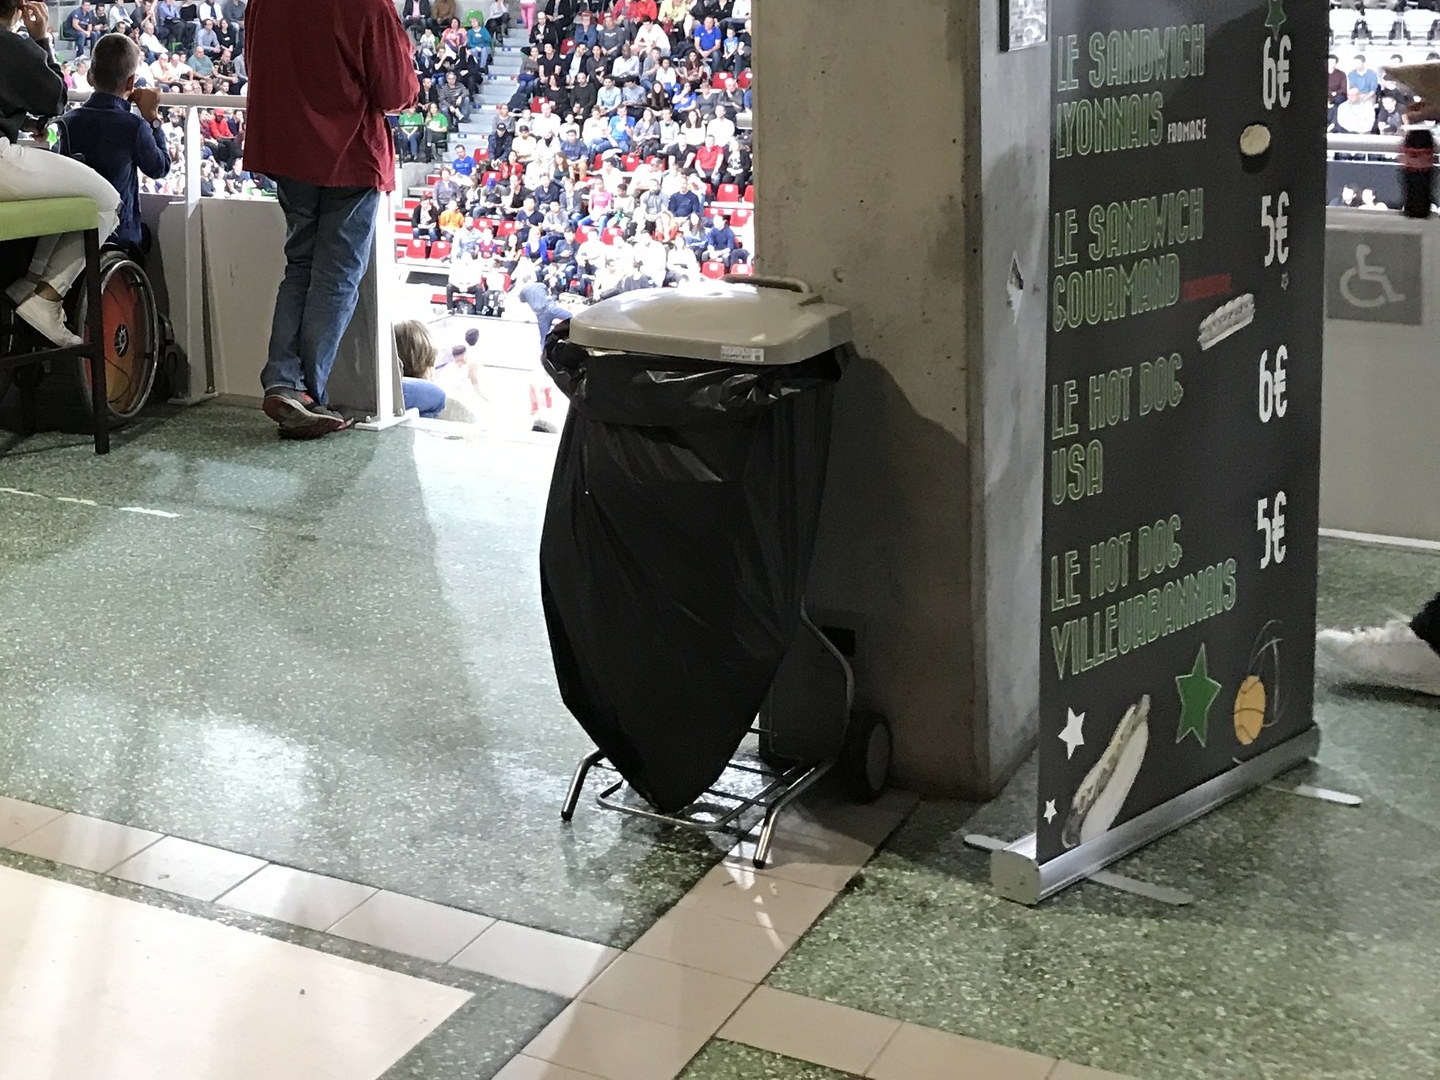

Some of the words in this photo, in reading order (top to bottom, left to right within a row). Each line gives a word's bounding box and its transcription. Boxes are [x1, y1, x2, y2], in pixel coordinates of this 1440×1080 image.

[1057, 34, 1079, 92] LE
[1088, 23, 1205, 89] SANDWICH
[1262, 34, 1291, 110] 6€
[1056, 90, 1164, 159] LYONNAIS
[1167, 118, 1207, 144] FROMAGE
[1054, 209, 1078, 268] LE
[1088, 187, 1203, 261] SANDWICH
[1261, 190, 1289, 267] 5€
[1053, 252, 1180, 333] GOURMAND
[1051, 379, 1079, 440] LE
[1089, 366, 1133, 431] HOT
[1139, 352, 1183, 416] DOG
[1259, 344, 1288, 423] 6€
[1051, 438, 1103, 506] USA
[1051, 549, 1081, 612] LE
[1090, 532, 1131, 600] HOT
[1138, 514, 1183, 581] DOG
[1257, 490, 1287, 569] 5€
[1051, 557, 1237, 680] VILLEURBANNAIS
